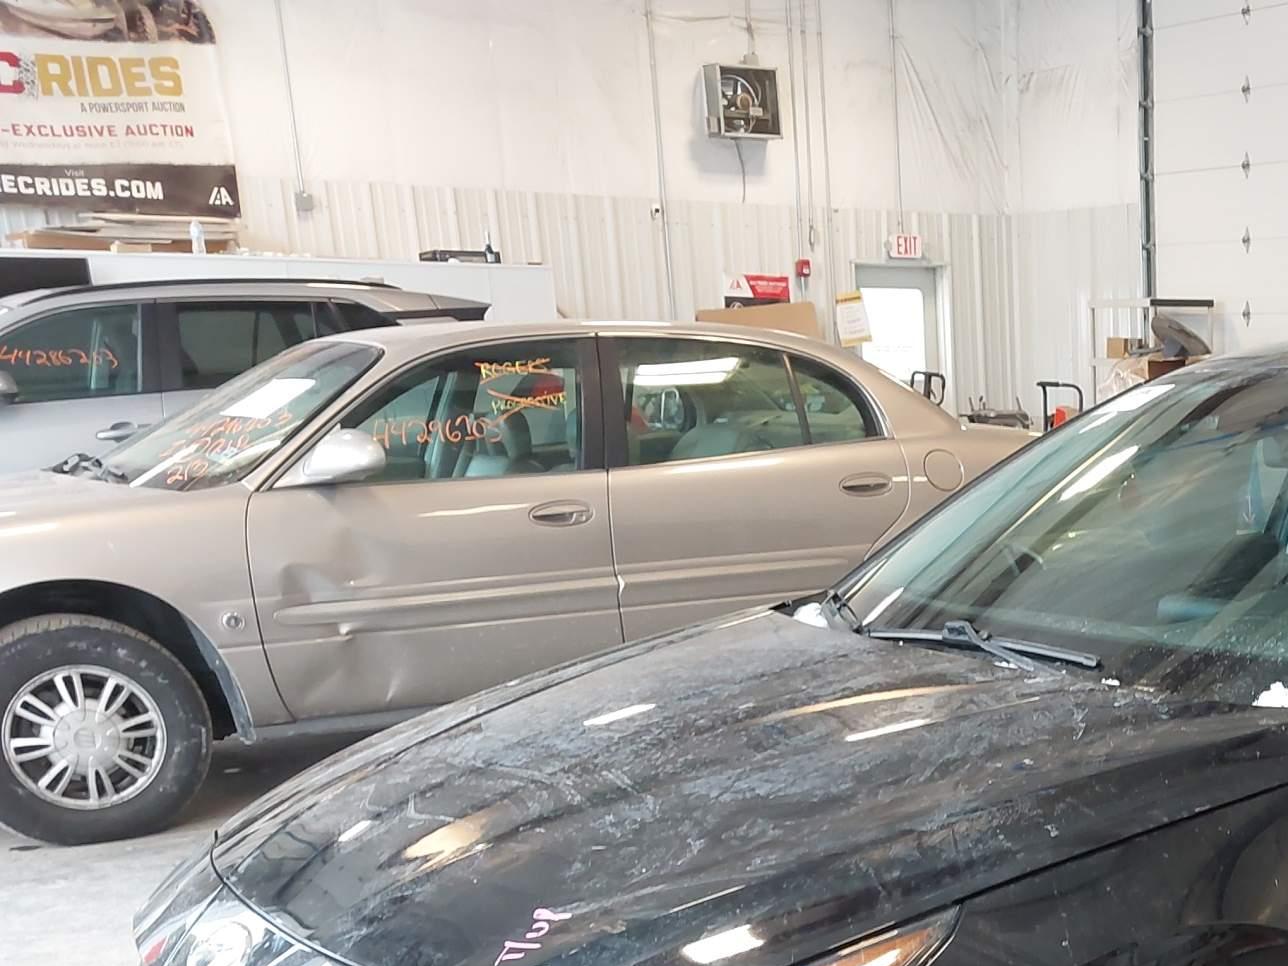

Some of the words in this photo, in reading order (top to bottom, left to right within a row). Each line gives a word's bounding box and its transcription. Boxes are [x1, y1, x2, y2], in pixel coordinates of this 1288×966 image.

[35, 54, 183, 97] RIDES
[80, 102, 88, 113] A
[88, 102, 149, 113] POWERSPORT
[152, 102, 186, 113] AUCTION
[125, 123, 195, 138] AUCTION
[65, 168, 84, 177] Visit
[0, 174, 164, 200] ECRIDES.COM
[896, 235, 918, 256] EXIT
